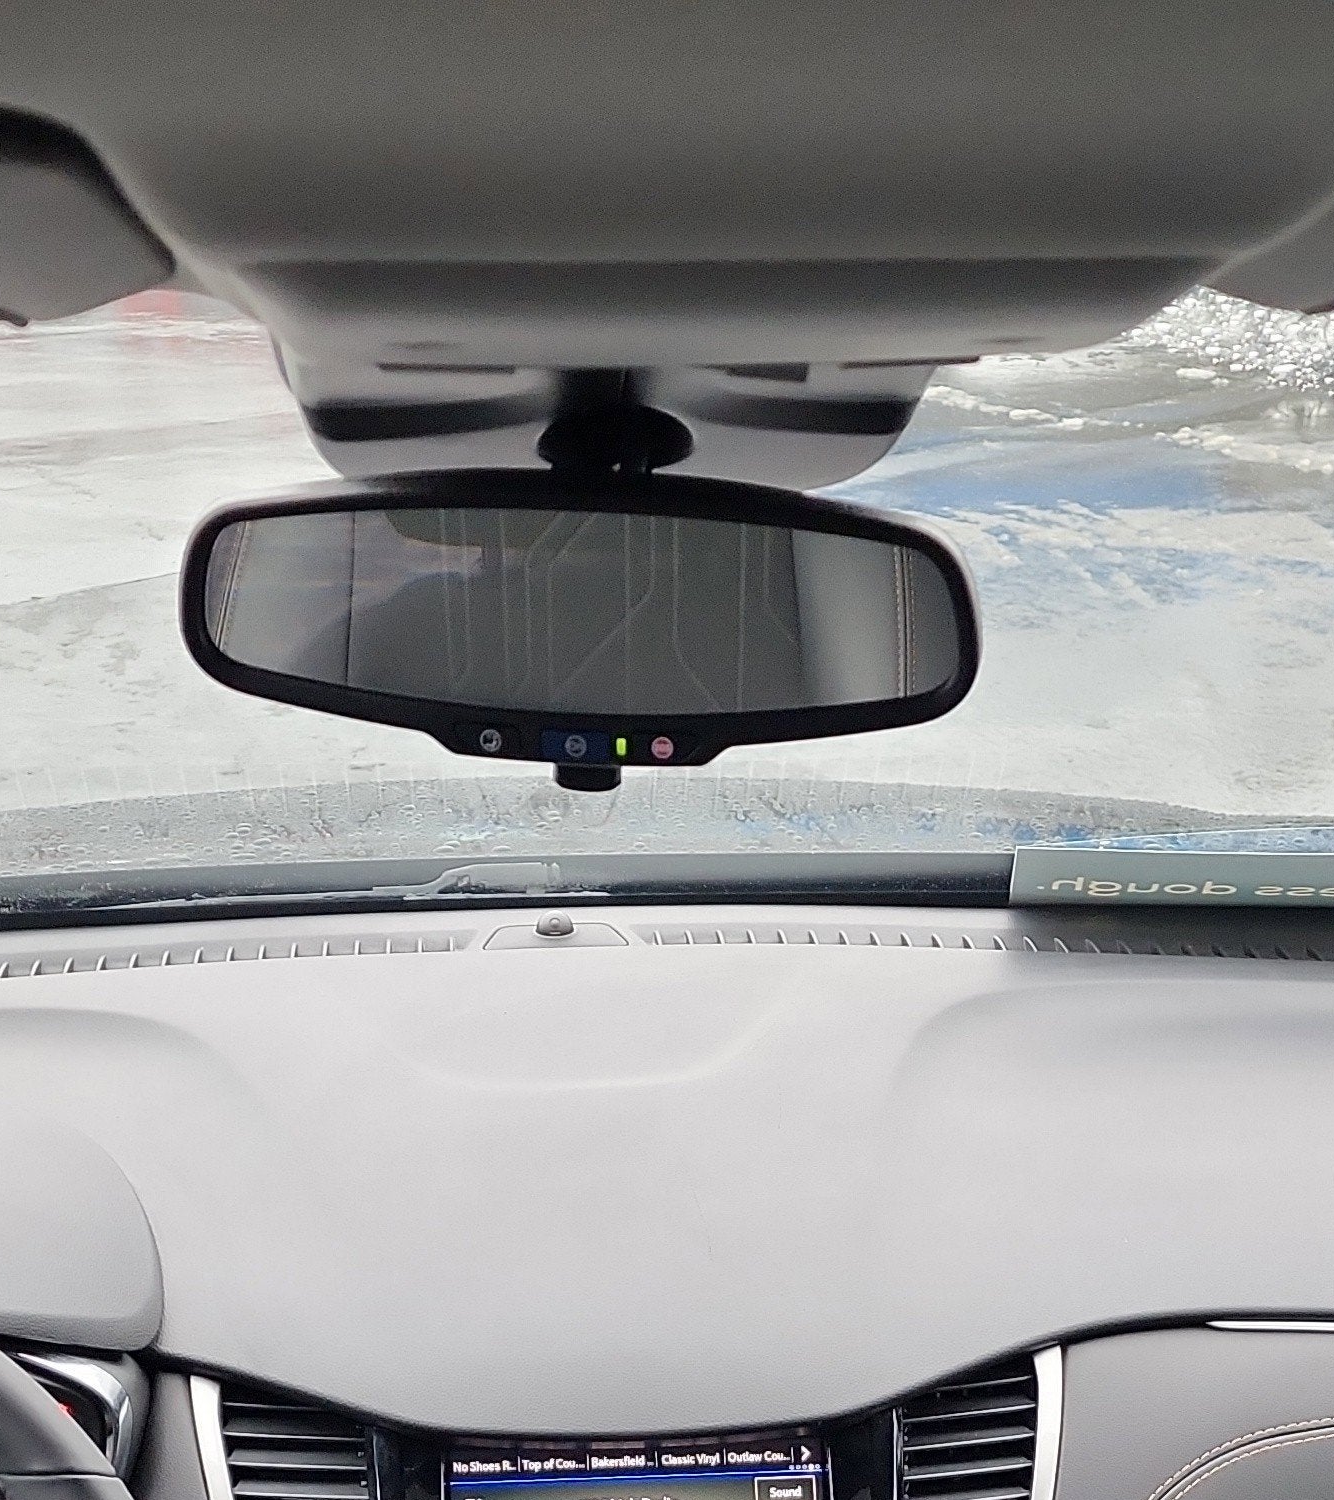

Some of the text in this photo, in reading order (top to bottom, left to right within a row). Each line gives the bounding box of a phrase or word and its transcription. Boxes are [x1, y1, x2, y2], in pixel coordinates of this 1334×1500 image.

[591, 1455, 646, 1468] Bakersfield
[661, 1452, 720, 1467] Classic Vinyl
[727, 1452, 762, 1463] Outlaw
[453, 1461, 501, 1473] No Shoes
[521, 1459, 542, 1472] Top
[543, 1458, 555, 1470] of
[769, 1485, 802, 1498] Sound
